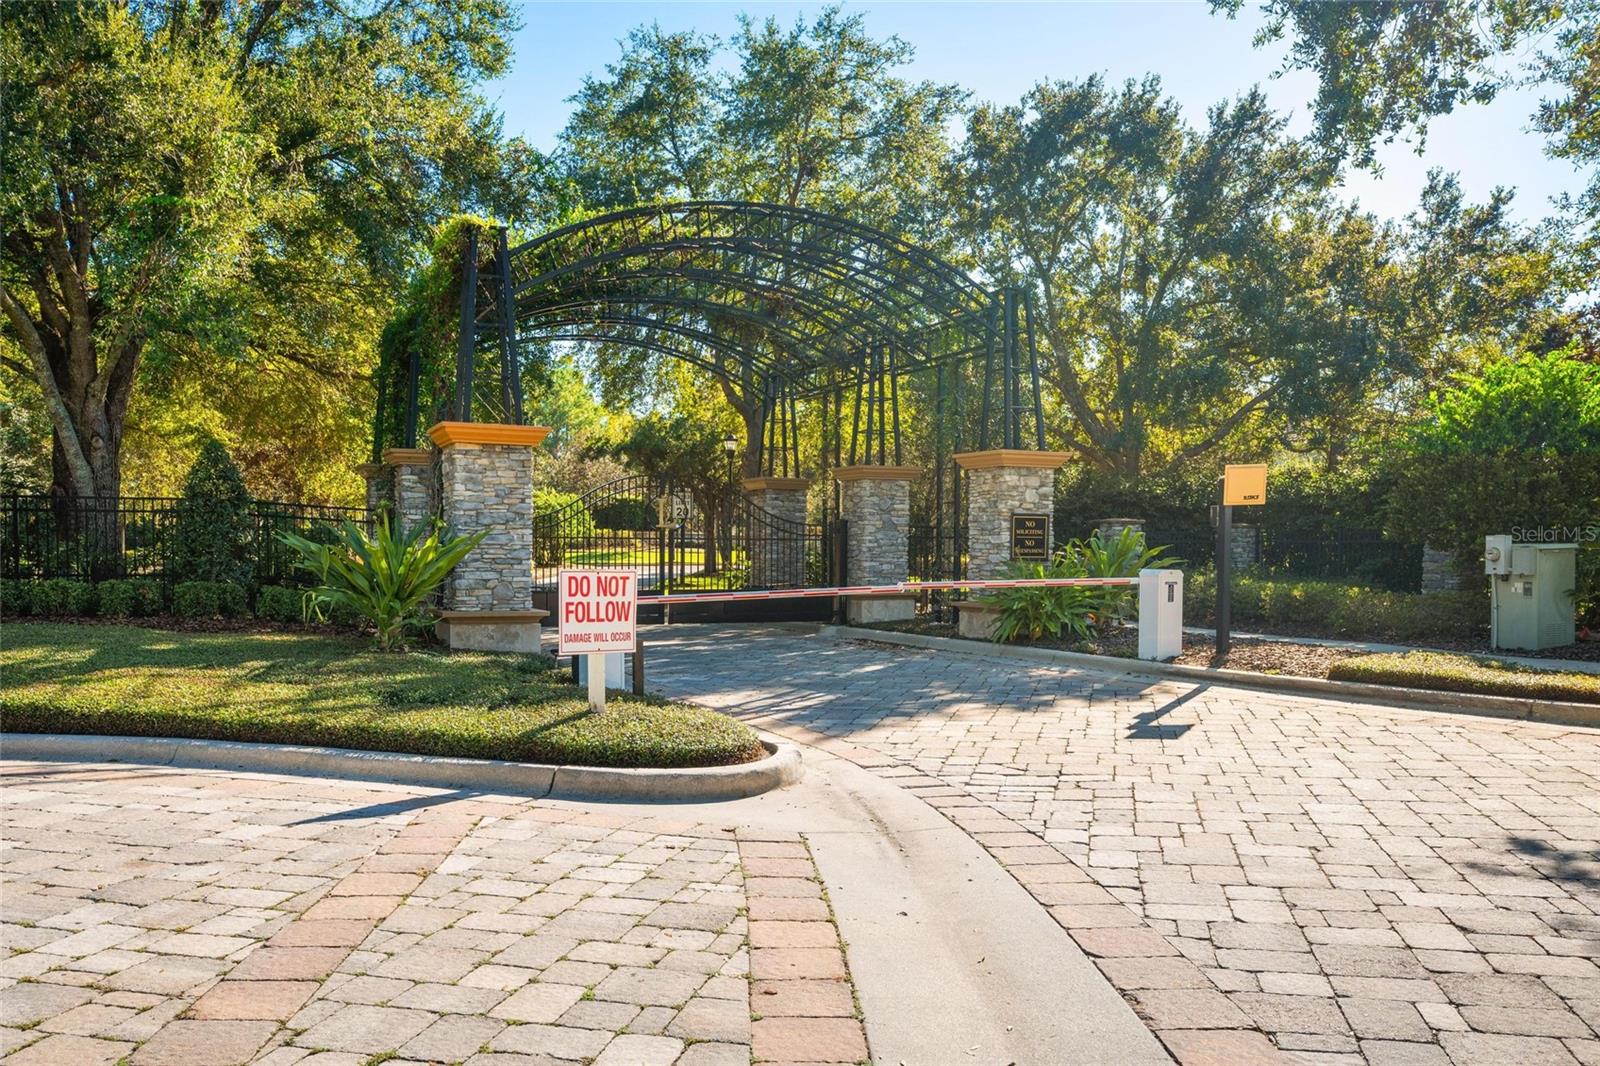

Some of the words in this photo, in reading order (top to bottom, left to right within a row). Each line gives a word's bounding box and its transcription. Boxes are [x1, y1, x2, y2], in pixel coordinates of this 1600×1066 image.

[1025, 520, 1036, 528] NO
[568, 575, 591, 597] DO
[596, 575, 630, 597] NOT
[565, 601, 631, 623] FOLLOW
[564, 633, 592, 643] DAMAGE
[594, 632, 609, 642] WILL
[610, 631, 632, 642] OCCUR
